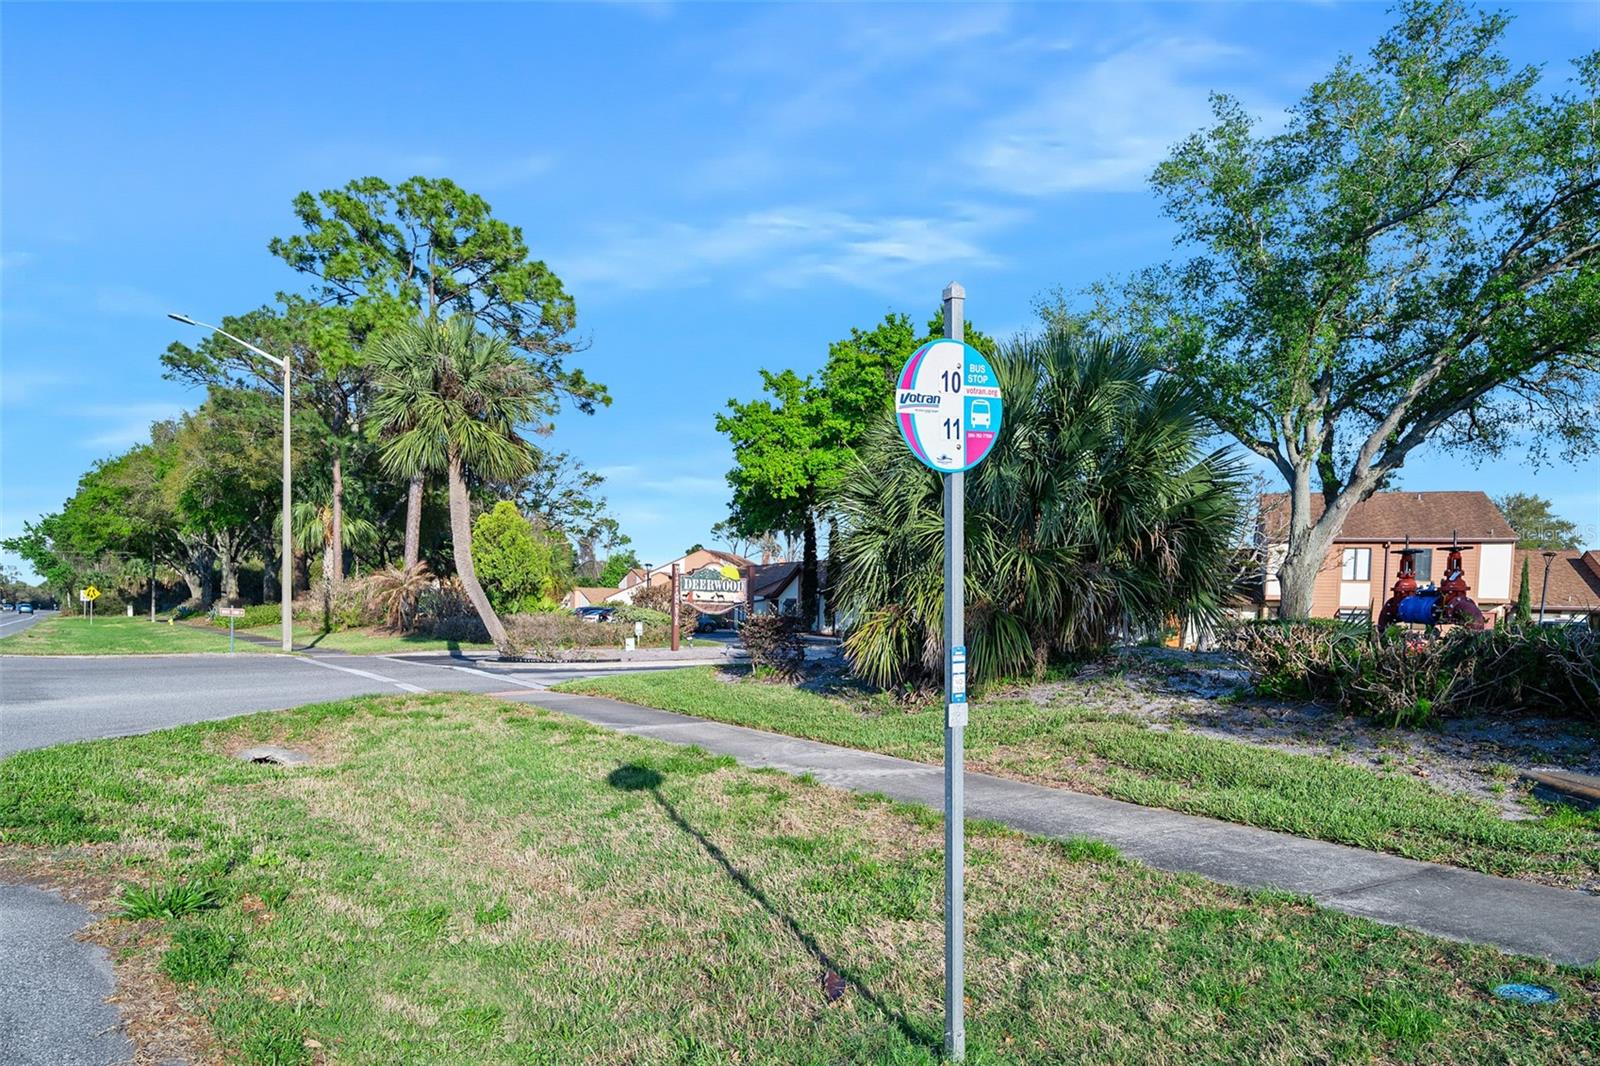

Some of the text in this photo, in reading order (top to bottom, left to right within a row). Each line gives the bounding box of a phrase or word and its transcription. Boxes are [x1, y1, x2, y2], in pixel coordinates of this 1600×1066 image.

[969, 364, 986, 373] BUS
[941, 370, 961, 394] 10
[967, 374, 989, 383] STOP
[900, 392, 941, 404] Votran
[966, 387, 998, 397] votran.org
[943, 417, 960, 440] 11
[683, 578, 744, 593] DEERWOOD
